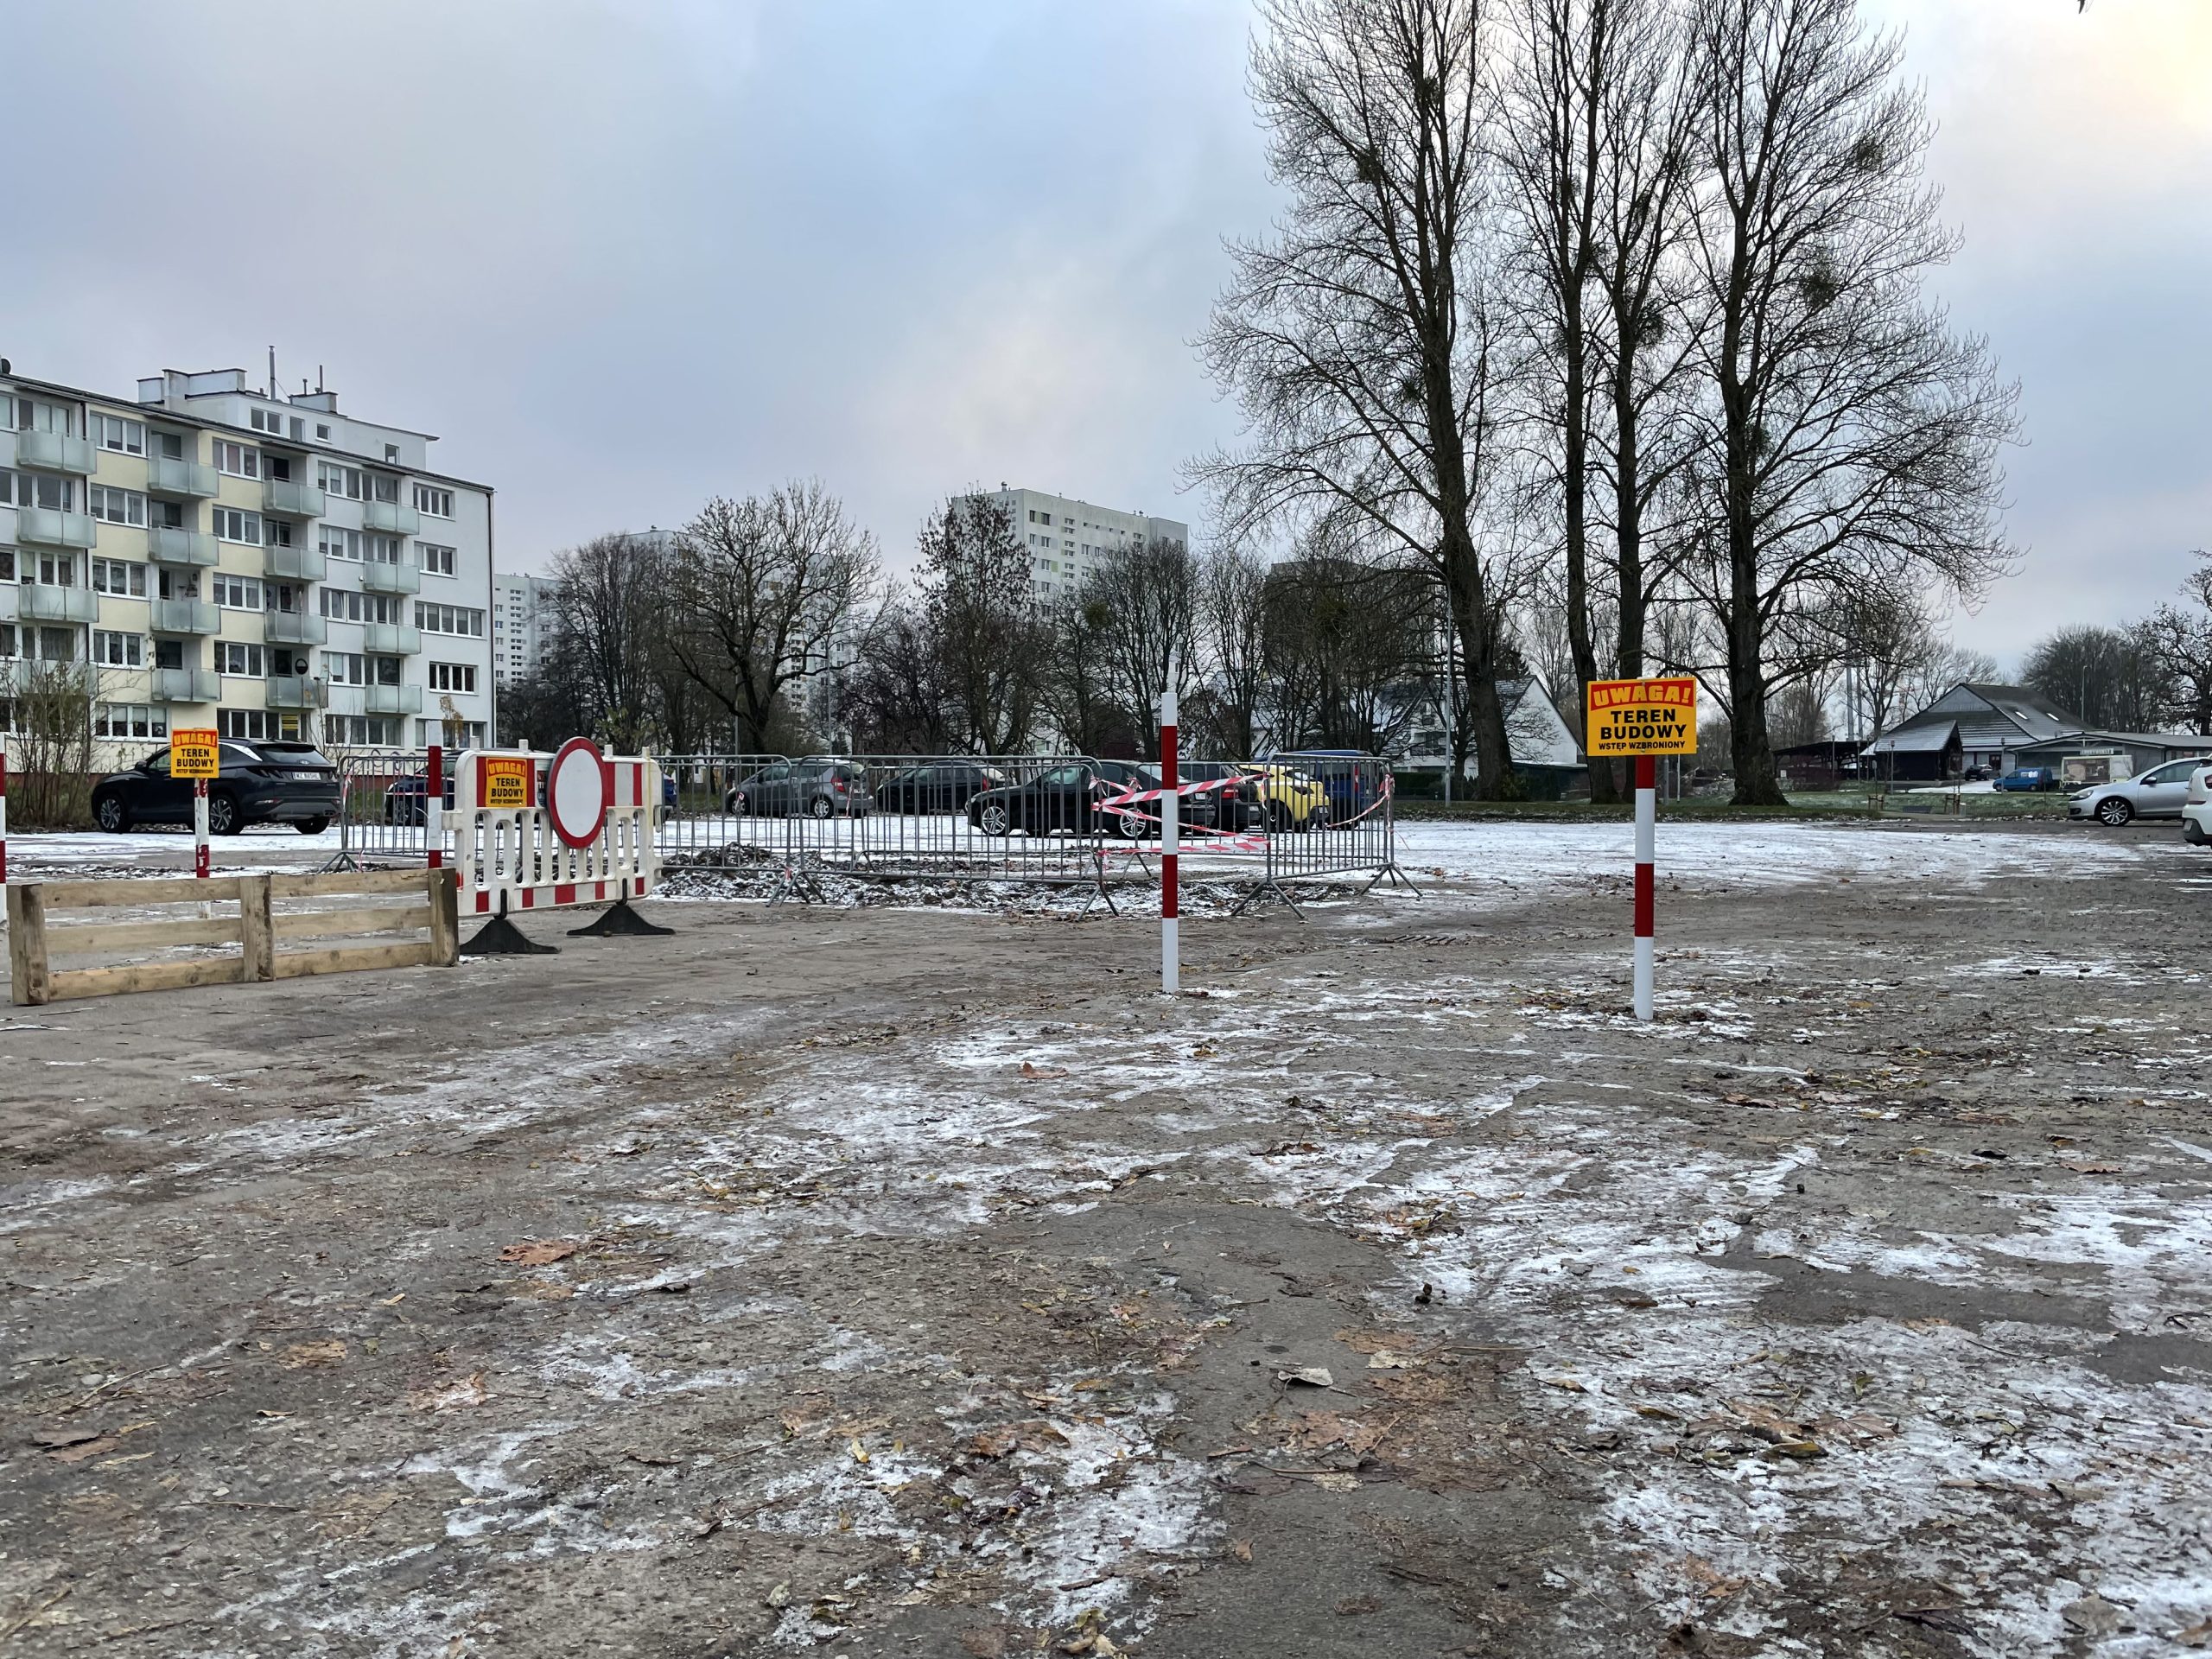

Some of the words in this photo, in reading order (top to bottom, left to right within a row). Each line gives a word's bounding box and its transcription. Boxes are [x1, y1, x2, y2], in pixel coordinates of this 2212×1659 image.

[1593, 685, 1691, 707] UWAGA!
[1611, 709, 1676, 724] TEREN
[1600, 724, 1687, 740] BUDOWY
[174, 733, 216, 746] UWAGA!
[181, 748, 210, 757] TEREN
[1599, 742, 1627, 752] WSTĘP
[1629, 741, 1686, 750] WZBRONIONY
[176, 758, 214, 767] BUDOWY
[488, 761, 525, 775] UWAGA!
[496, 778, 520, 787] TEREN
[491, 788, 524, 797] BUDOWY
